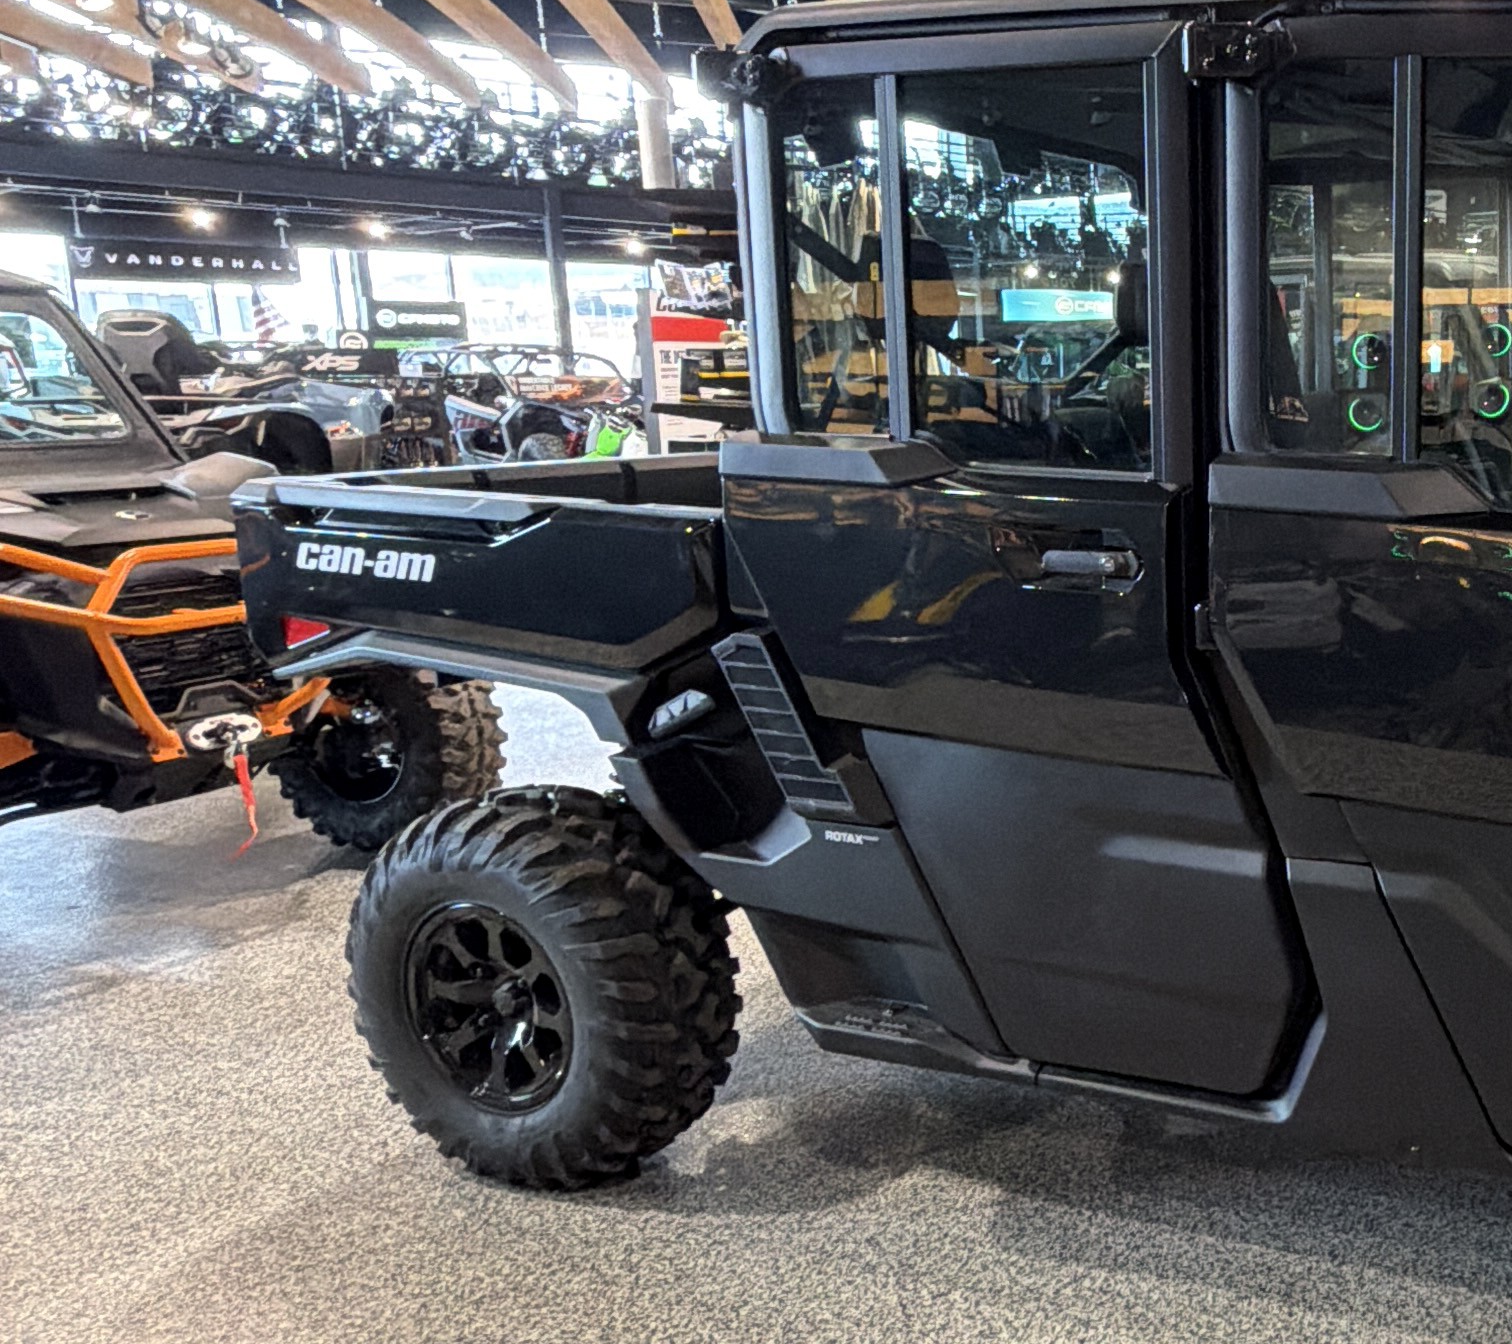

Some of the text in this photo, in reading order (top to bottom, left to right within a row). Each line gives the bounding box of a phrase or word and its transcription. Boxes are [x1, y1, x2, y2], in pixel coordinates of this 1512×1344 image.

[104, 252, 298, 272] VANDERHALL
[301, 352, 363, 371] XPS
[295, 541, 437, 583] can-am
[824, 829, 864, 845] ROTAX
